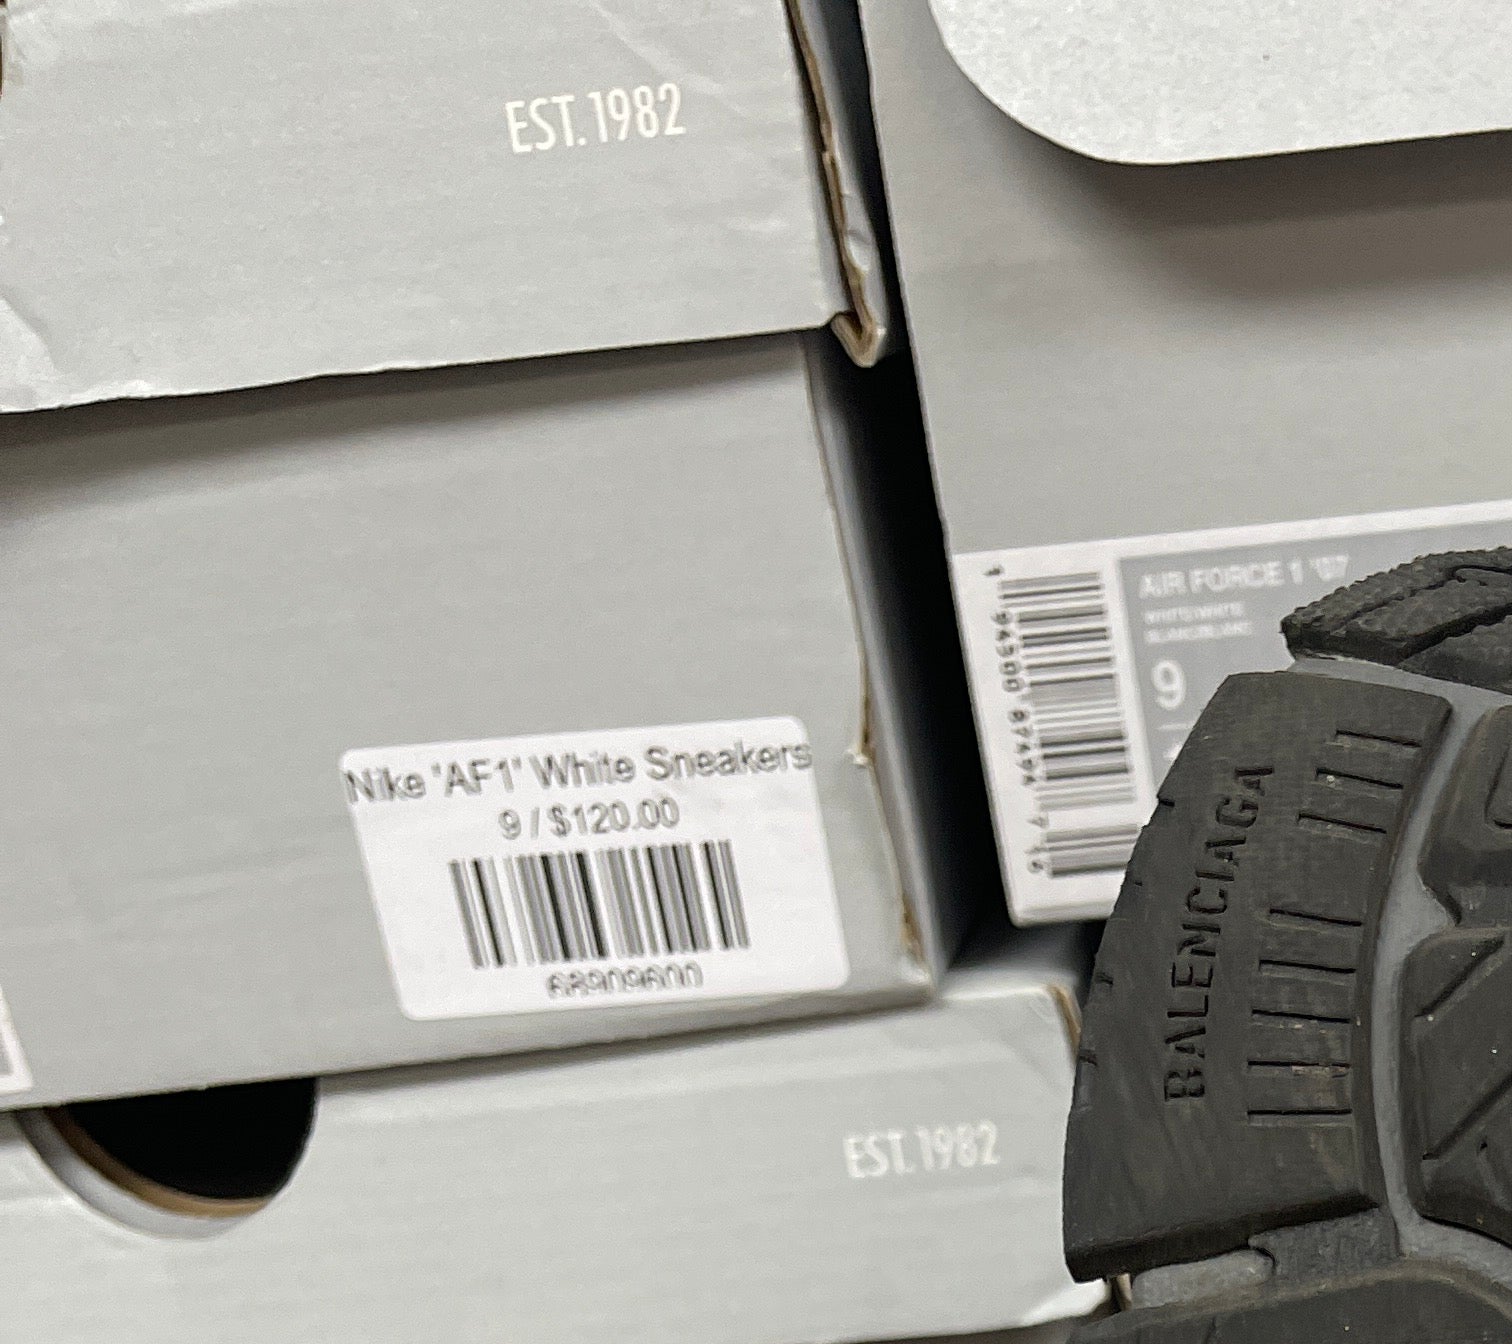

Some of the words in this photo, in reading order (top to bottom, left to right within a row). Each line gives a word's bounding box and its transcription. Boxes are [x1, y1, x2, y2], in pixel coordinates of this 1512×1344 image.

[1138, 570, 1187, 600] AIR
[1190, 560, 1285, 595] FORCE
[1151, 658, 1187, 710] 9
[343, 766, 427, 805] Nike
[533, 751, 636, 790] White
[647, 739, 813, 783] Sneakers
[500, 808, 522, 840] 9
[549, 796, 680, 839] $120.00
[1163, 766, 1275, 1103] BALENCIAGA
